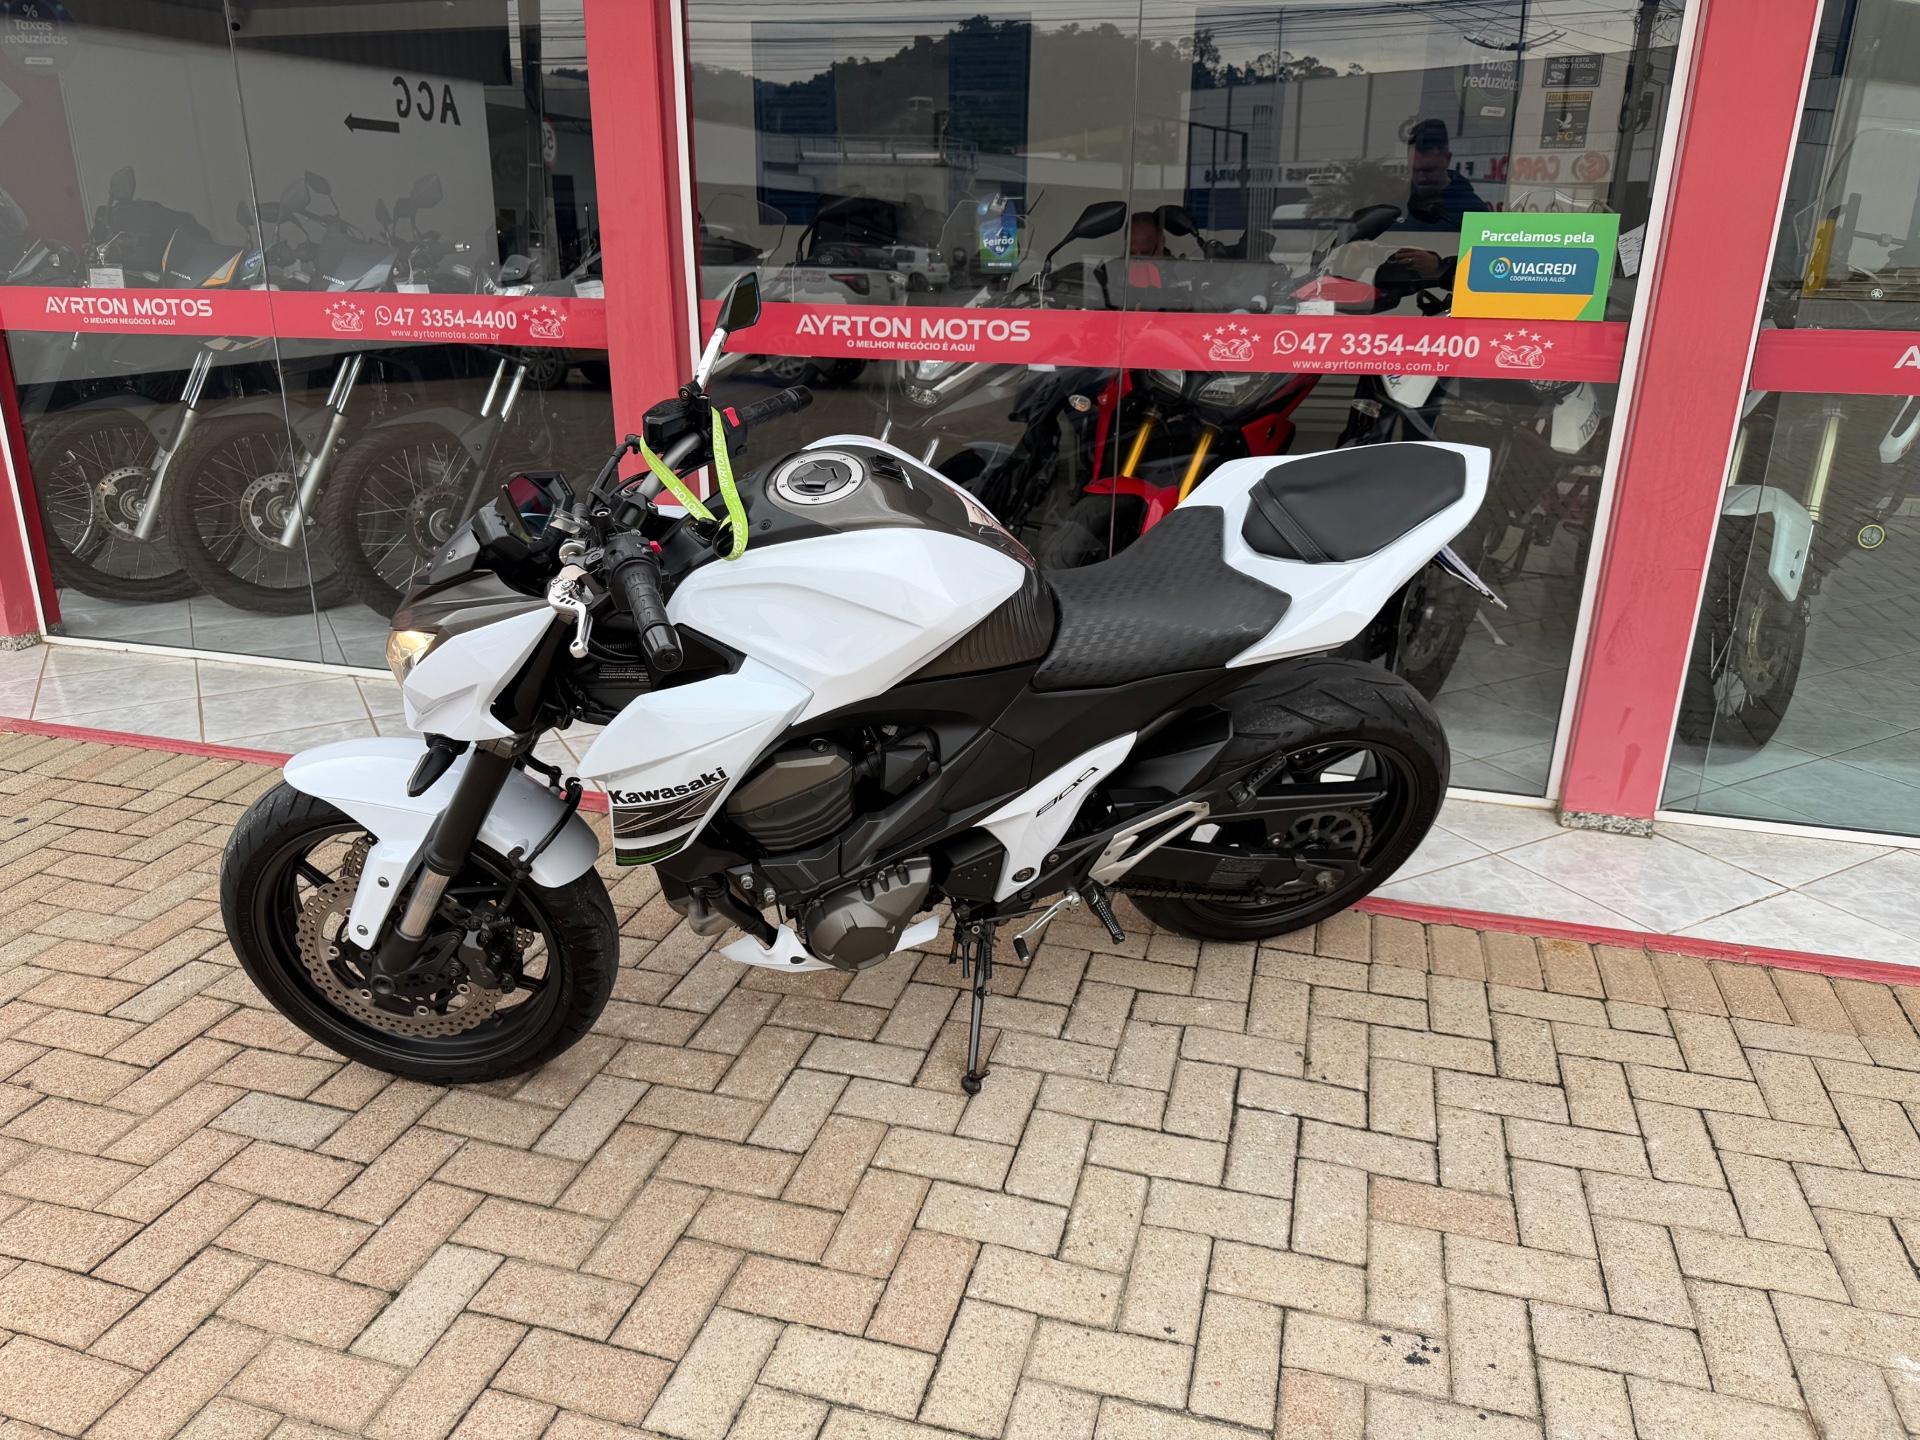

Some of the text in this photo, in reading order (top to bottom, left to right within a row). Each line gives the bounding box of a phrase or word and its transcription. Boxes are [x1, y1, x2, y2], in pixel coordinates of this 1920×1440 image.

[14, 19, 53, 31] Taxas
[4, 31, 69, 45] reduzidas
[1480, 56, 1514, 72] Taxas
[983, 235, 1014, 248] Feirão
[1481, 230, 1595, 245] Parcelamos pela
[1512, 262, 1577, 276] VIACREDI
[45, 296, 213, 317] AYRTON MOTOS
[90, 317, 118, 325] MELHOR
[119, 317, 151, 326] NEGÓCIO
[394, 308, 517, 330] 47 3354-4400
[391, 328, 500, 341] www.ayrtonmotos.com.br
[795, 314, 1031, 342] AYRTON MOTOS
[847, 340, 976, 352] O MELHOR NEGÓCIO É AQUI
[1300, 332, 1480, 358] 47 3354-4400
[1292, 359, 1450, 372] www.ayrtonmotos.com.br
[608, 766, 727, 805] Kawasaki
[1035, 766, 1100, 818] 800
